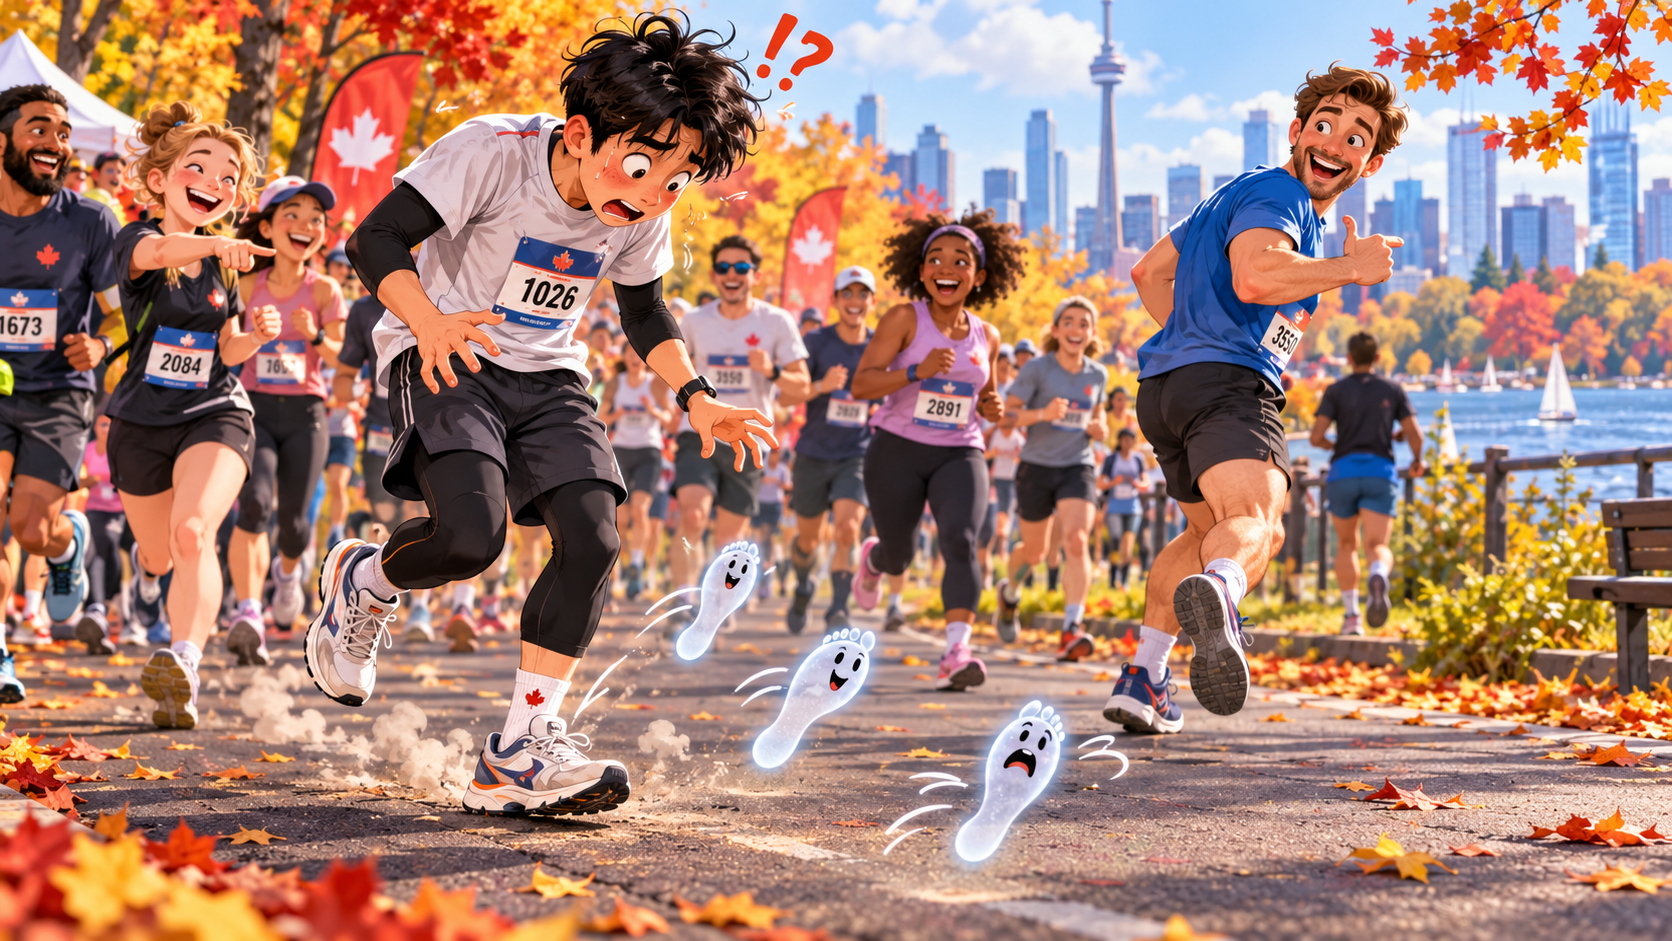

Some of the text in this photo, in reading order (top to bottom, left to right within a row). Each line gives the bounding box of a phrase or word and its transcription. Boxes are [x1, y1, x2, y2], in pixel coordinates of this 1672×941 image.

[521, 277, 579, 311] 1026
[0, 315, 42, 336] 1673
[1271, 324, 1298, 355] 3550
[160, 352, 202, 375] 2084
[926, 398, 961, 418] 2891
